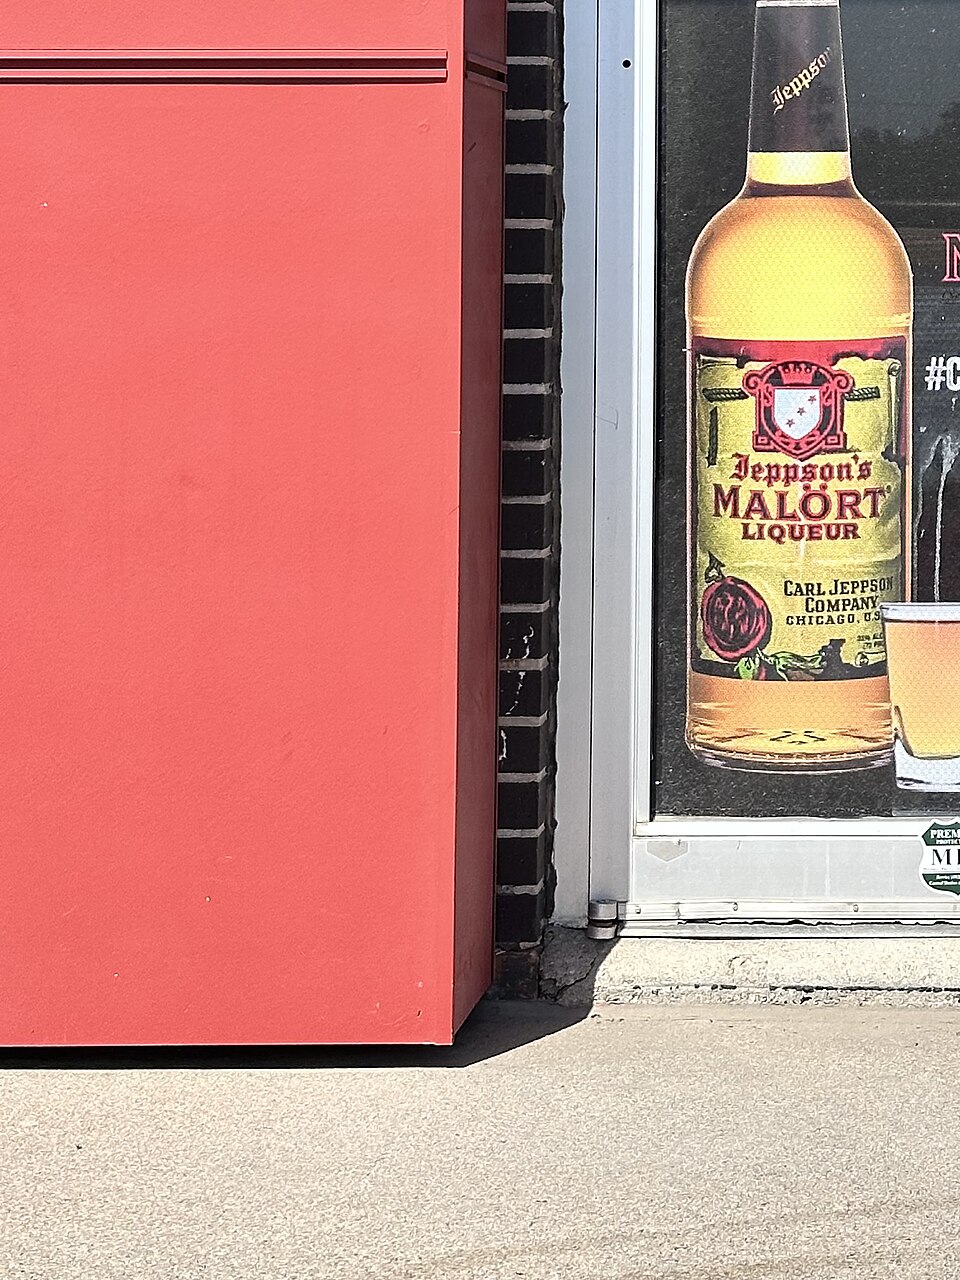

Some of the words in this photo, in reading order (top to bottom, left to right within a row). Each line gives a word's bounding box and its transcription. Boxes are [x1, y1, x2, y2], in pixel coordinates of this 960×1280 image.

[729, 452, 873, 487] Jeppson's
[712, 483, 887, 521] MALÖRT
[741, 523, 861, 545] LIQUEUR
[783, 580, 826, 596] CARL
[829, 576, 894, 595] JEPPSON
[805, 595, 880, 613] COMPANY
